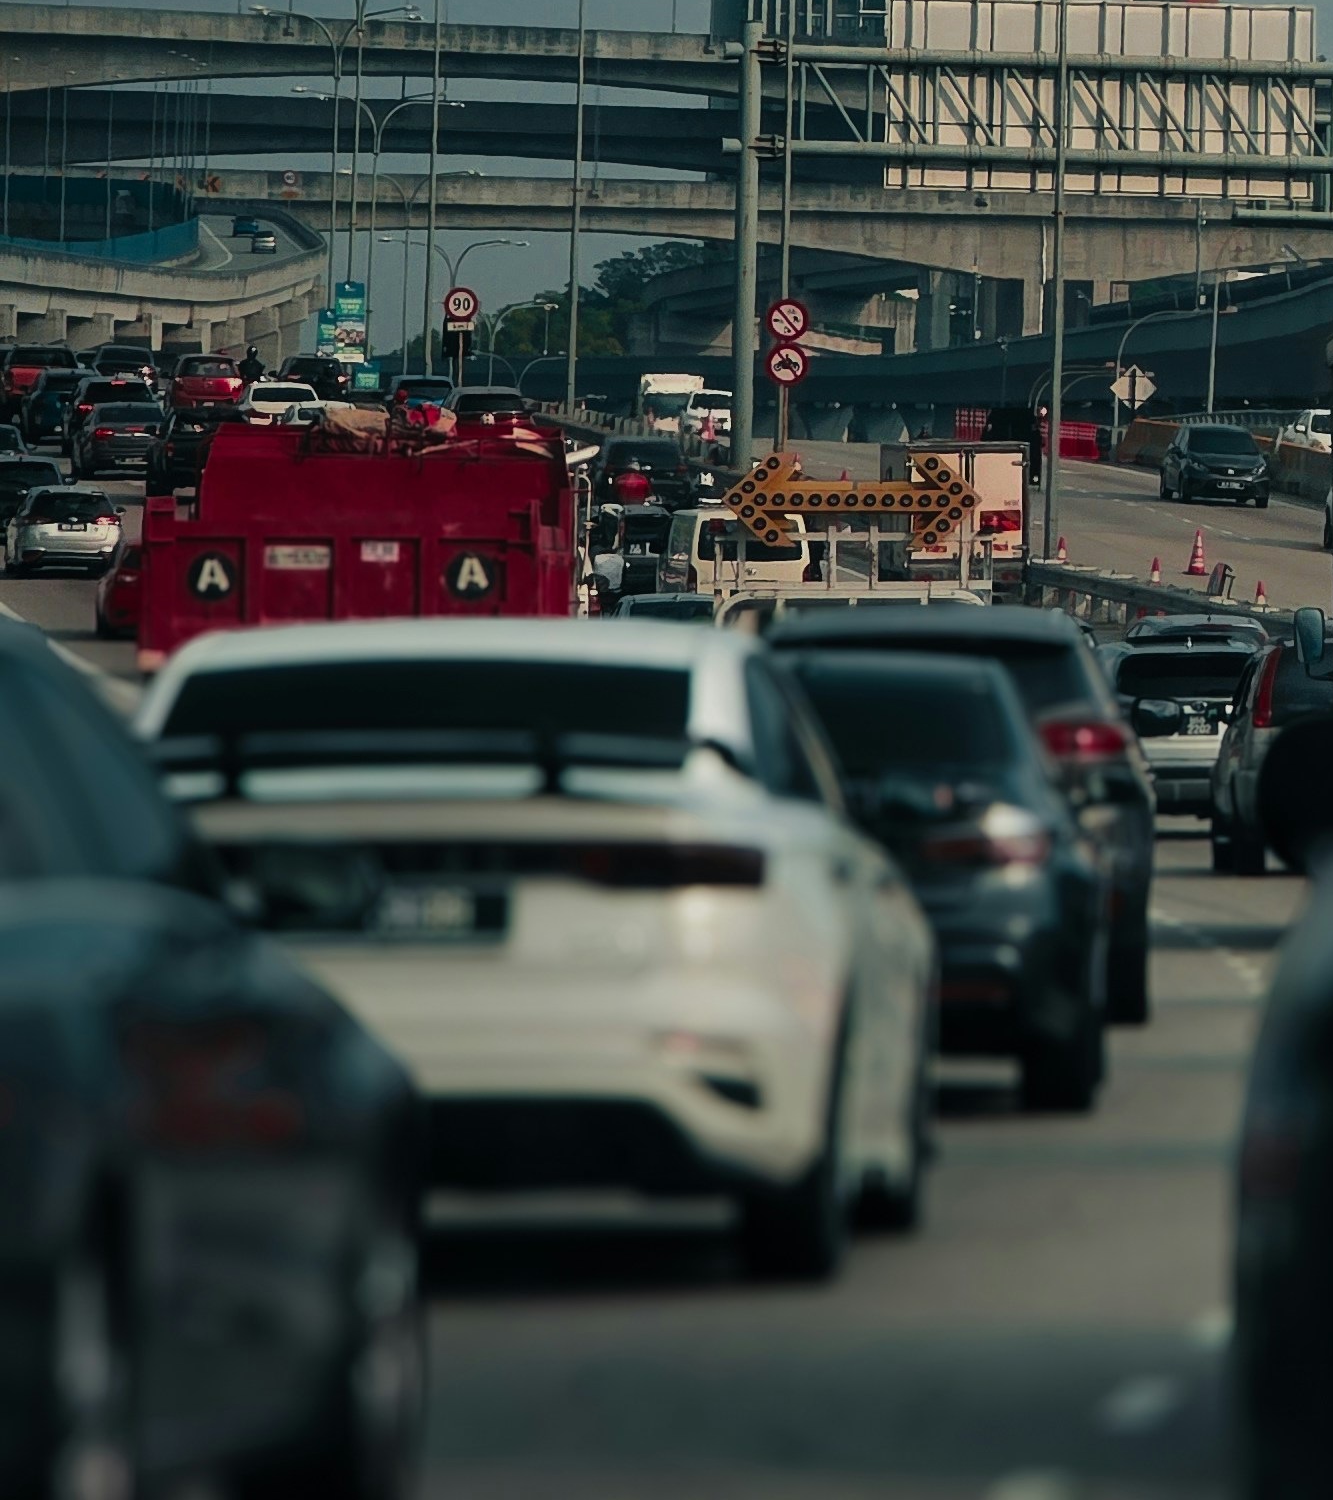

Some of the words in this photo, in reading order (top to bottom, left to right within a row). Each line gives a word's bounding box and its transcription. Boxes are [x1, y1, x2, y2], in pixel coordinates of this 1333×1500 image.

[453, 298, 471, 311] 90
[196, 558, 230, 593] A
[456, 556, 489, 591] A
